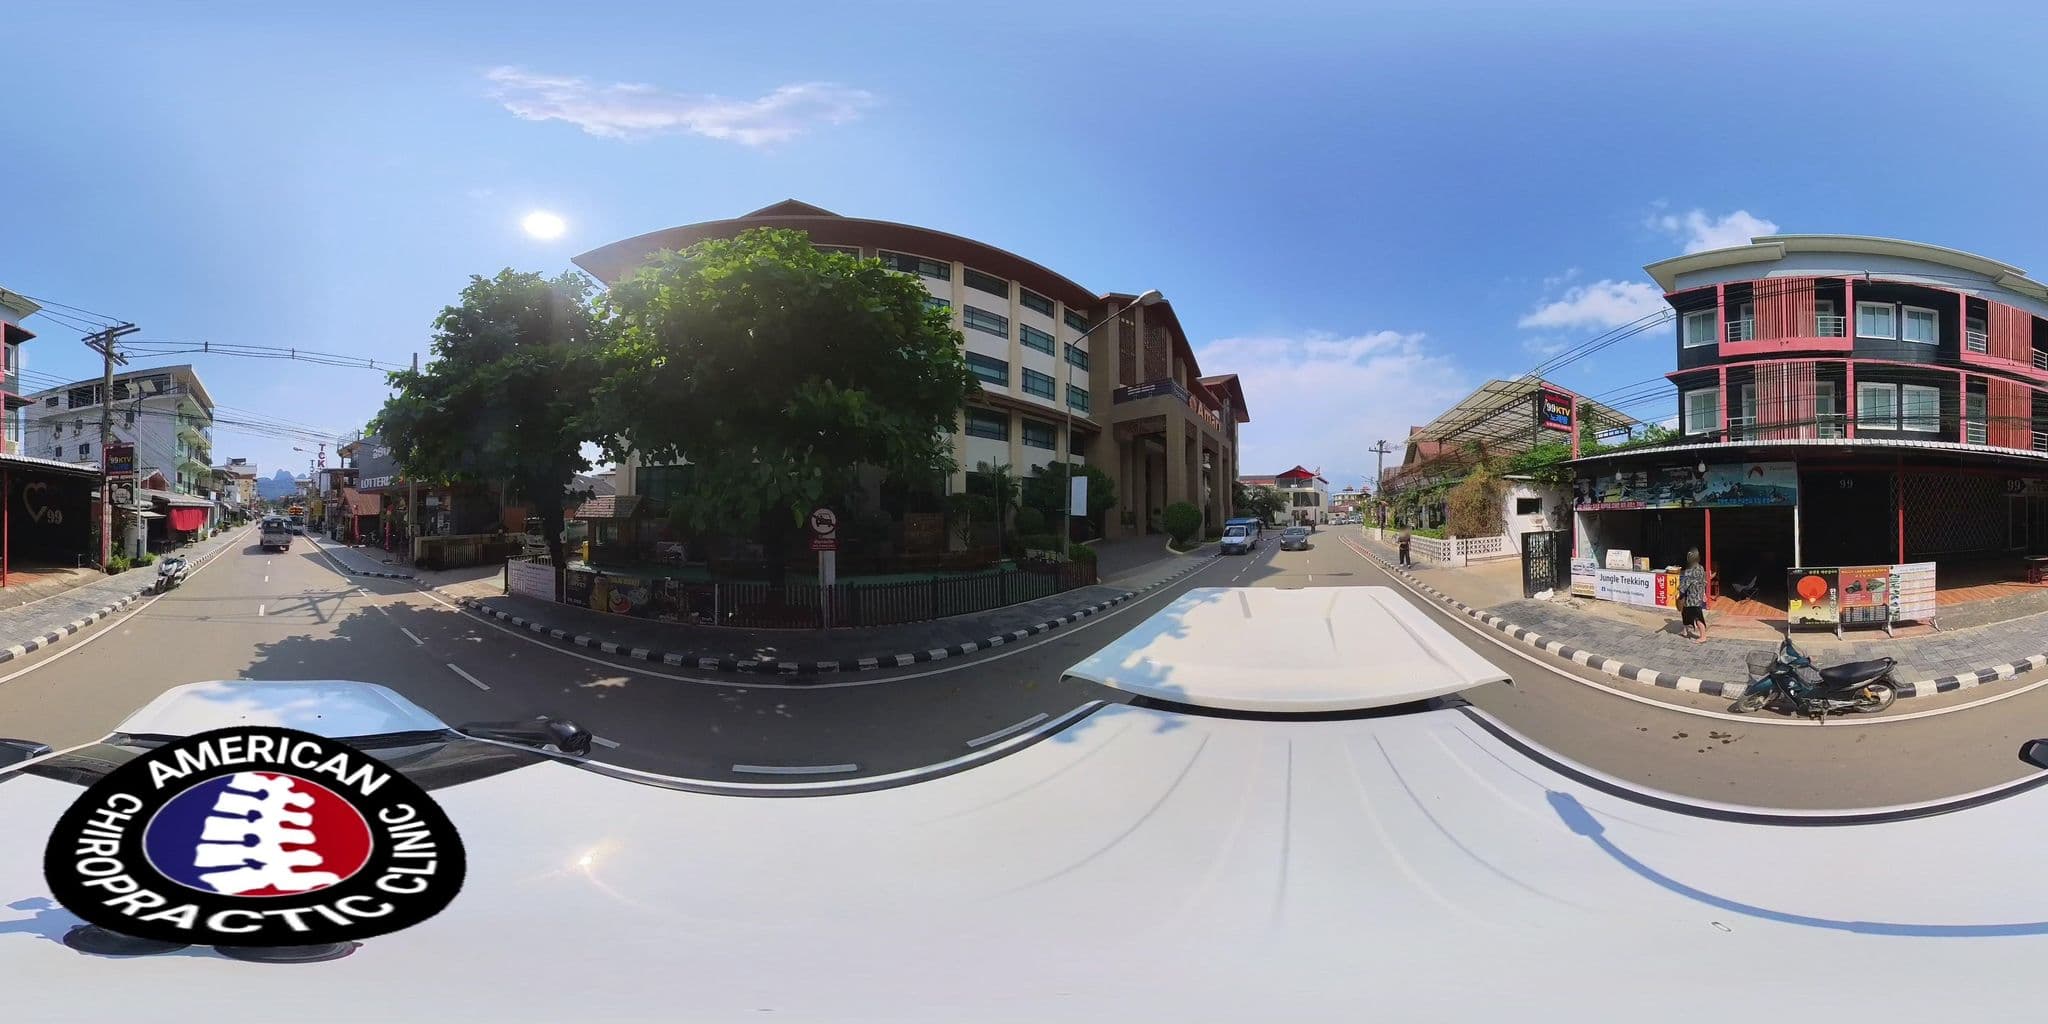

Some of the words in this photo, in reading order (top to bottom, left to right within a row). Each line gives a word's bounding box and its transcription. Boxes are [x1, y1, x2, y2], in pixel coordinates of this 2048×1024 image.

[1839, 479, 1853, 488] 99
[2007, 479, 2021, 491] 99
[47, 509, 63, 525] 99
[1599, 573, 1620, 585] Jungle
[1620, 575, 1650, 589] Trekking
